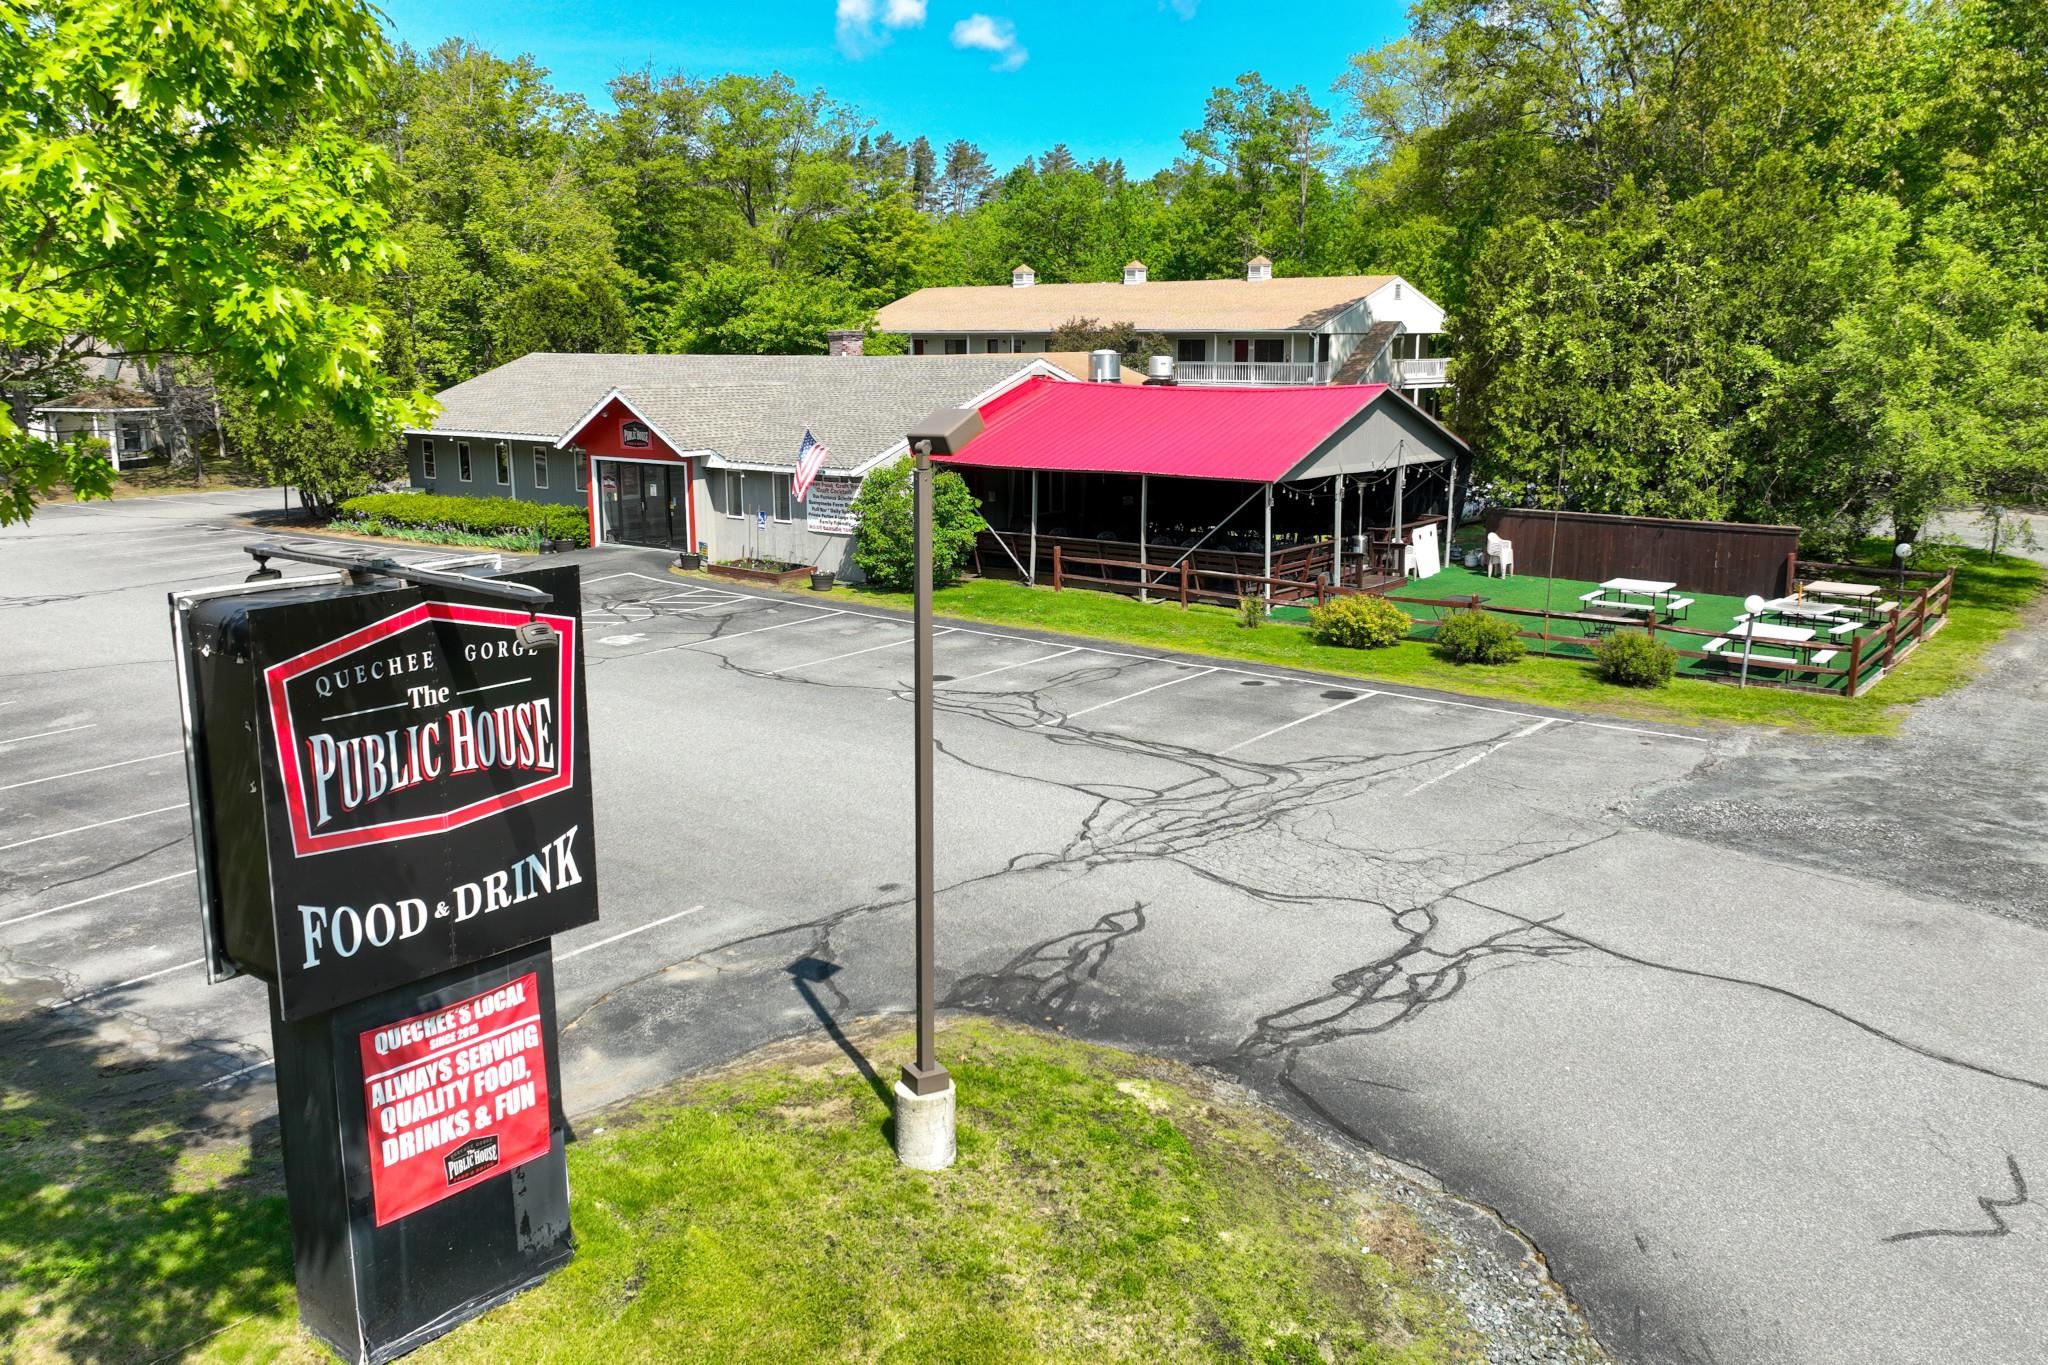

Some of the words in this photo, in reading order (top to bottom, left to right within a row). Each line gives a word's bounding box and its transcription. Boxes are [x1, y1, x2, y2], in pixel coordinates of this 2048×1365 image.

[315, 650, 434, 697] QUECHEE
[408, 684, 450, 709] The
[306, 721, 442, 828] PUBLIC
[446, 697, 555, 776] HOUSE
[297, 897, 428, 970] FOOD
[434, 901, 450, 919] &
[453, 824, 583, 923] DRINK
[374, 1004, 471, 1056] QUECHEE'S
[474, 982, 526, 1020] LOCAL
[429, 1030, 457, 1051] SINCE
[372, 1055, 454, 1109] ALWAYS
[455, 1024, 539, 1076] SERVING
[380, 1077, 470, 1134] QUALITY
[474, 1055, 532, 1098] FOOD,
[382, 1108, 470, 1168] DRINKS
[474, 1105, 493, 1130] &
[495, 1081, 537, 1121] FUN
[447, 1155, 474, 1181] PUBLIC
[474, 1143, 498, 1166] HOUSE
